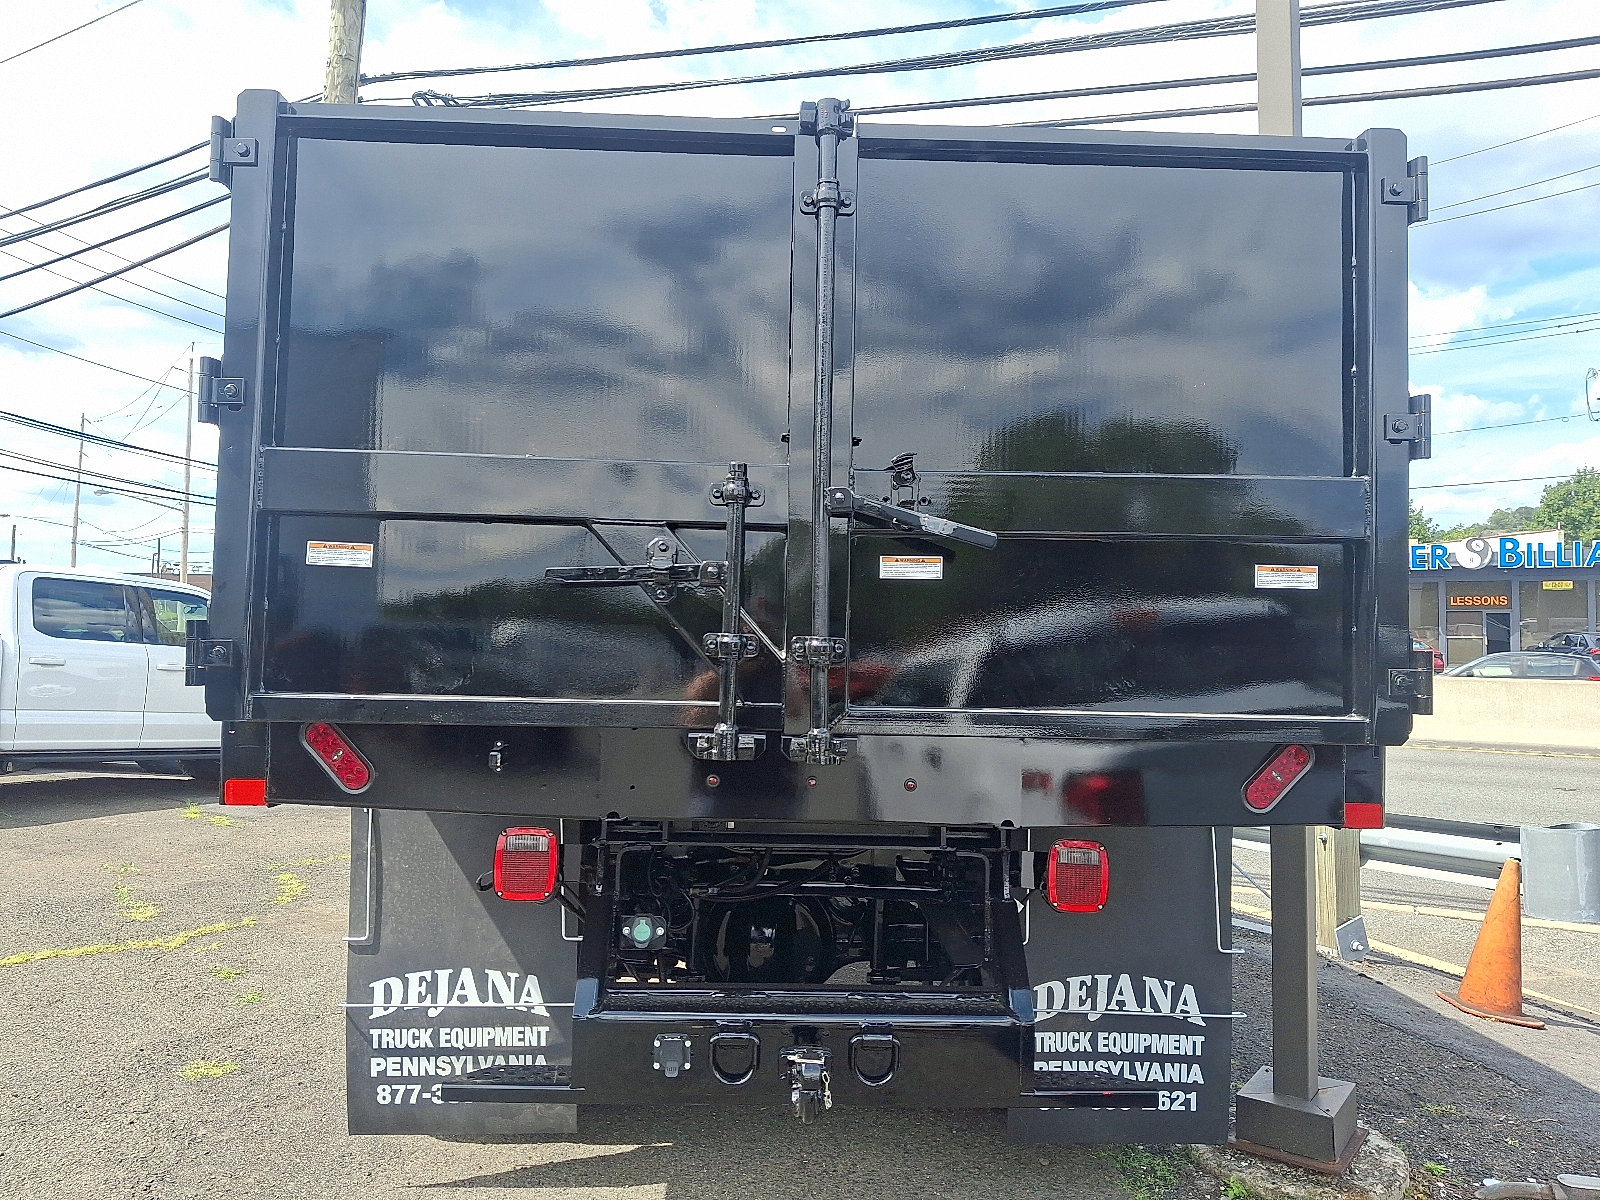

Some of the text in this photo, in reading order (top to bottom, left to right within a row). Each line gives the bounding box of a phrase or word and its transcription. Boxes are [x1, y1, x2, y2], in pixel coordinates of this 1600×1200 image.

[1450, 596, 1508, 606] LESSONS
[368, 967, 550, 1020] DEJANA
[1033, 973, 1207, 1027] DEJANA
[369, 1026, 550, 1051] TRUCK EQUIPMENT
[1034, 1031, 1206, 1056] TRUCK EQUIPMENT
[376, 1084, 472, 1105] 877-3
